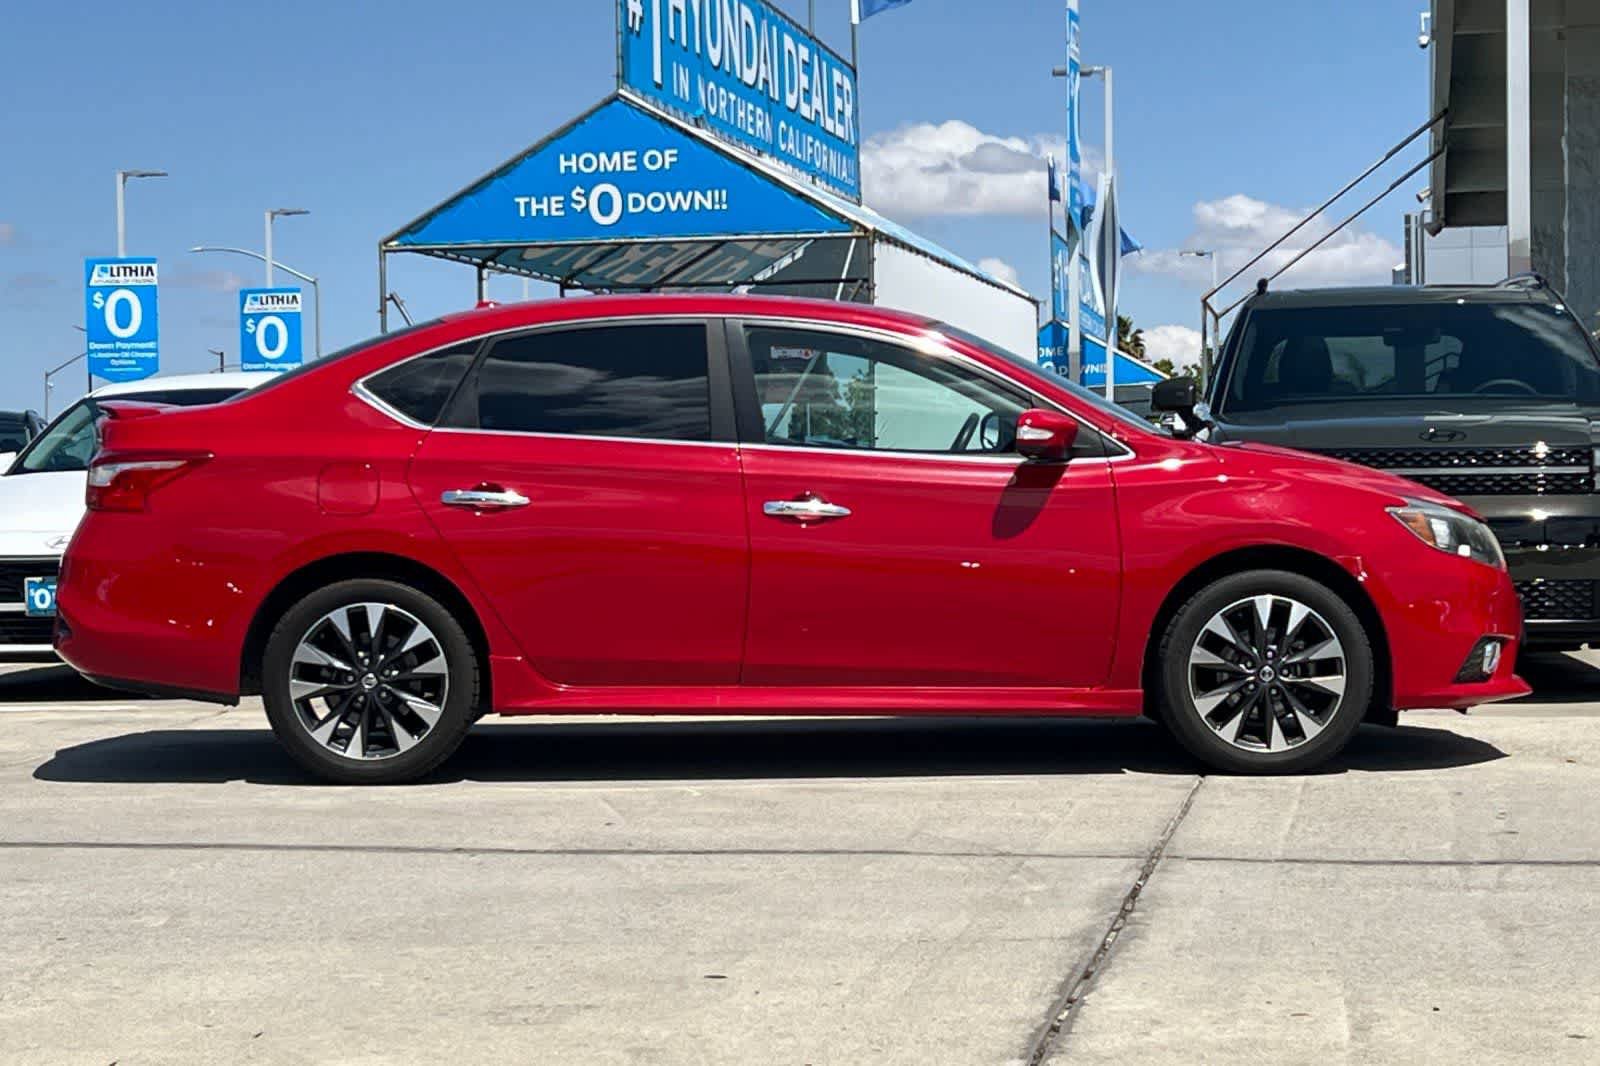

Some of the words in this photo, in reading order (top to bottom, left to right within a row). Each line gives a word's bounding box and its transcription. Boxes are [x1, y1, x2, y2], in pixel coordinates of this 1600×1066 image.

[668, 0, 780, 101] HYUNDAI
[783, 32, 856, 145] DEALER
[672, 61, 690, 101] IN
[697, 74, 773, 144] NORTHERN
[559, 151, 638, 174] HOME
[643, 149, 678, 171] OF
[514, 196, 565, 217] THE
[570, 183, 623, 225] $0
[627, 189, 728, 213] DOWN!!
[109, 265, 155, 278] LITHIA
[92, 288, 143, 338] $0
[259, 294, 299, 306] LITHIA
[245, 315, 289, 360] $0
[1039, 345, 1065, 358] OME
